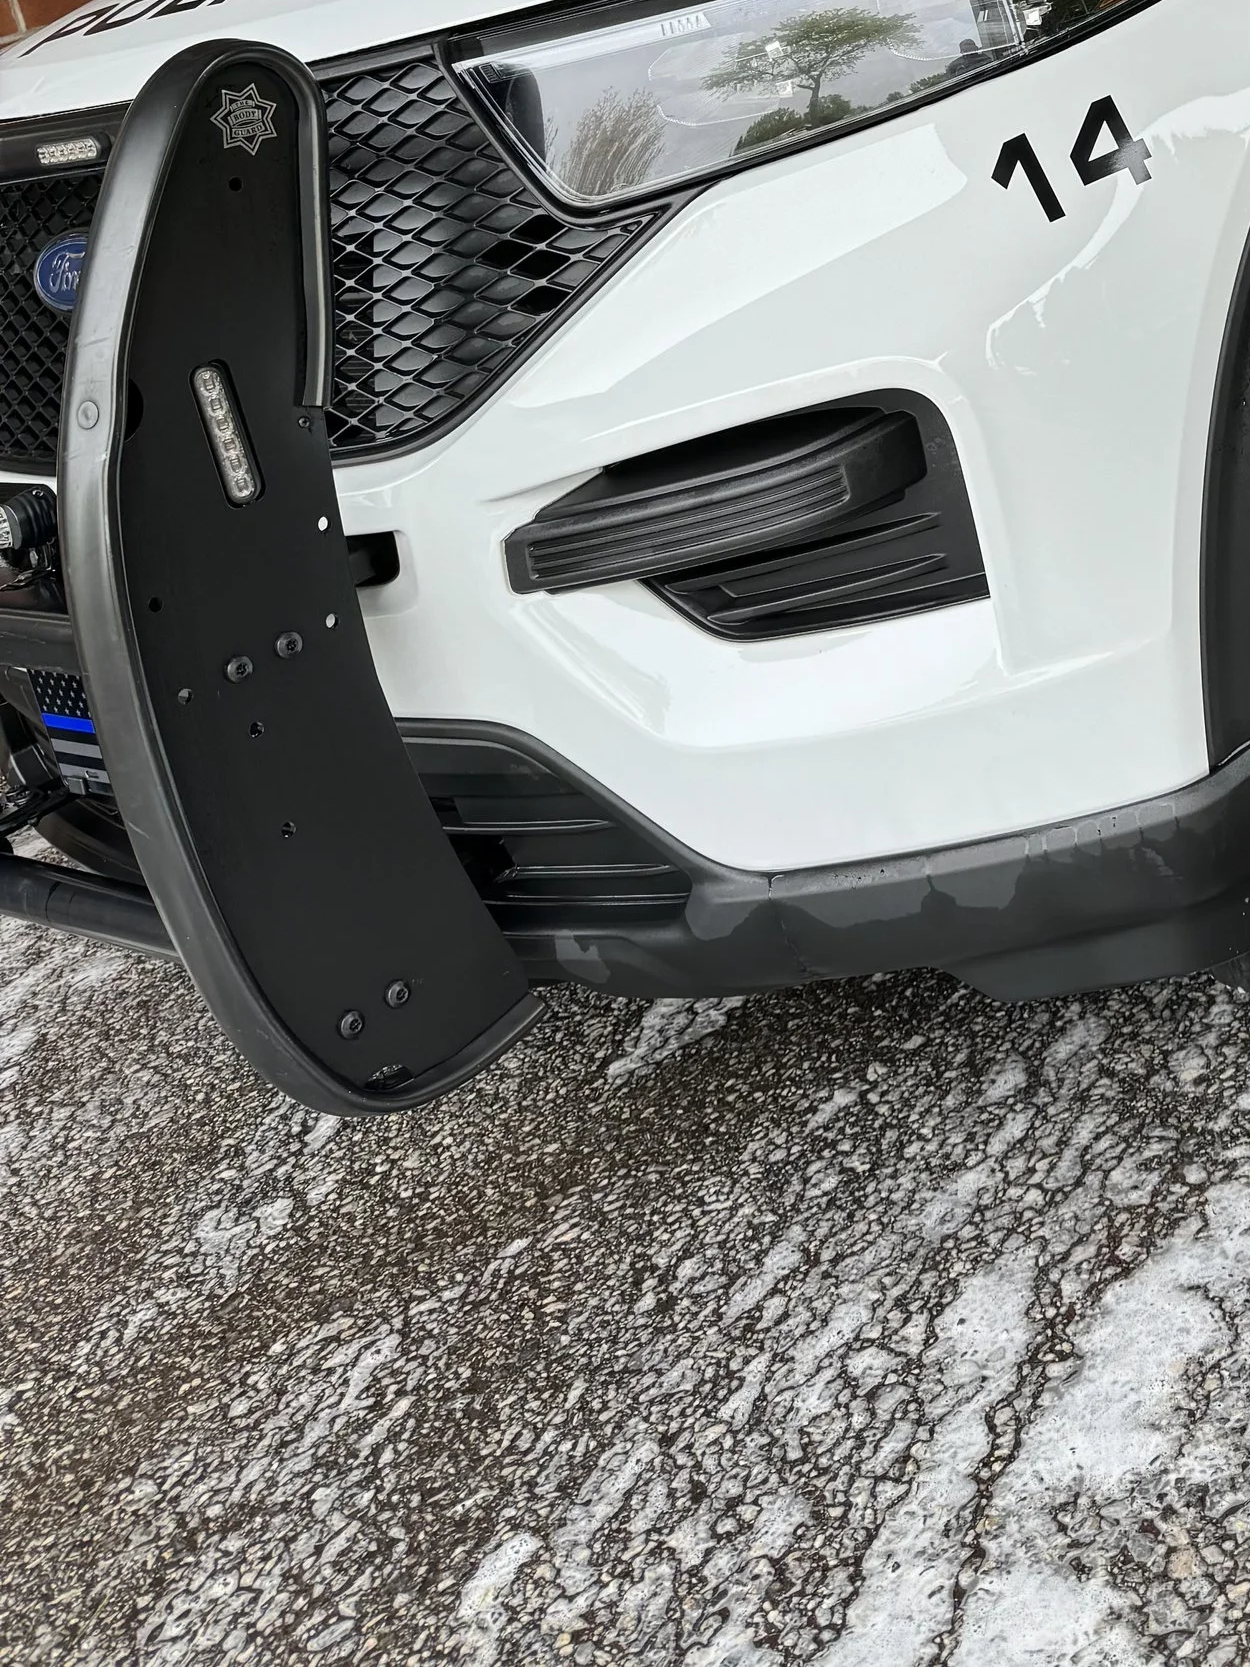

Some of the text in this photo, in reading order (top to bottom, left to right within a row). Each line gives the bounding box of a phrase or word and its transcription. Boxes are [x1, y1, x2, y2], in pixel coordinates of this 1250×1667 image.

[232, 110, 257, 122] BODY
[233, 124, 263, 136] GUARD
[990, 94, 1152, 223] 14
[49, 250, 85, 293] For
